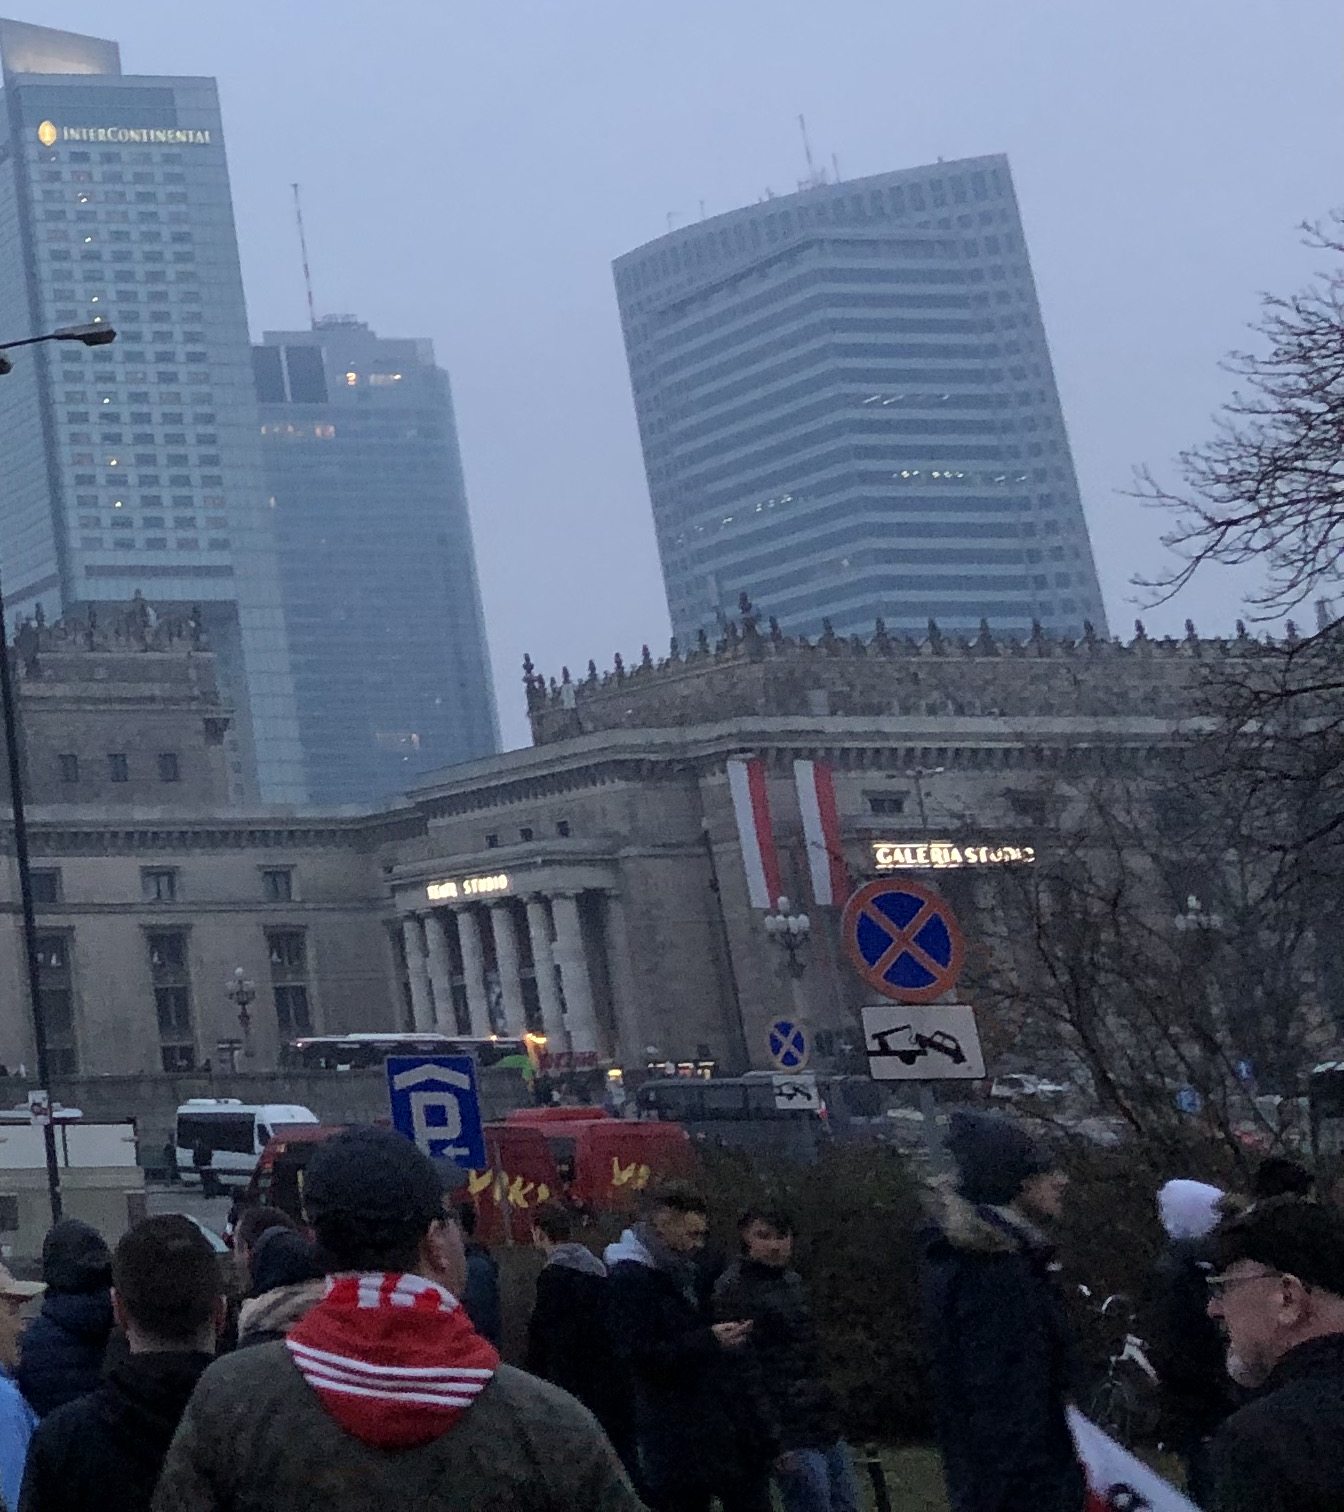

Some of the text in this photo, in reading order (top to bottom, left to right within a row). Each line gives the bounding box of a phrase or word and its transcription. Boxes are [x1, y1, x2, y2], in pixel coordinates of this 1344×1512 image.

[875, 847, 962, 864] GALERIA
[463, 874, 508, 895] STUDIO
[409, 1091, 462, 1158] P
